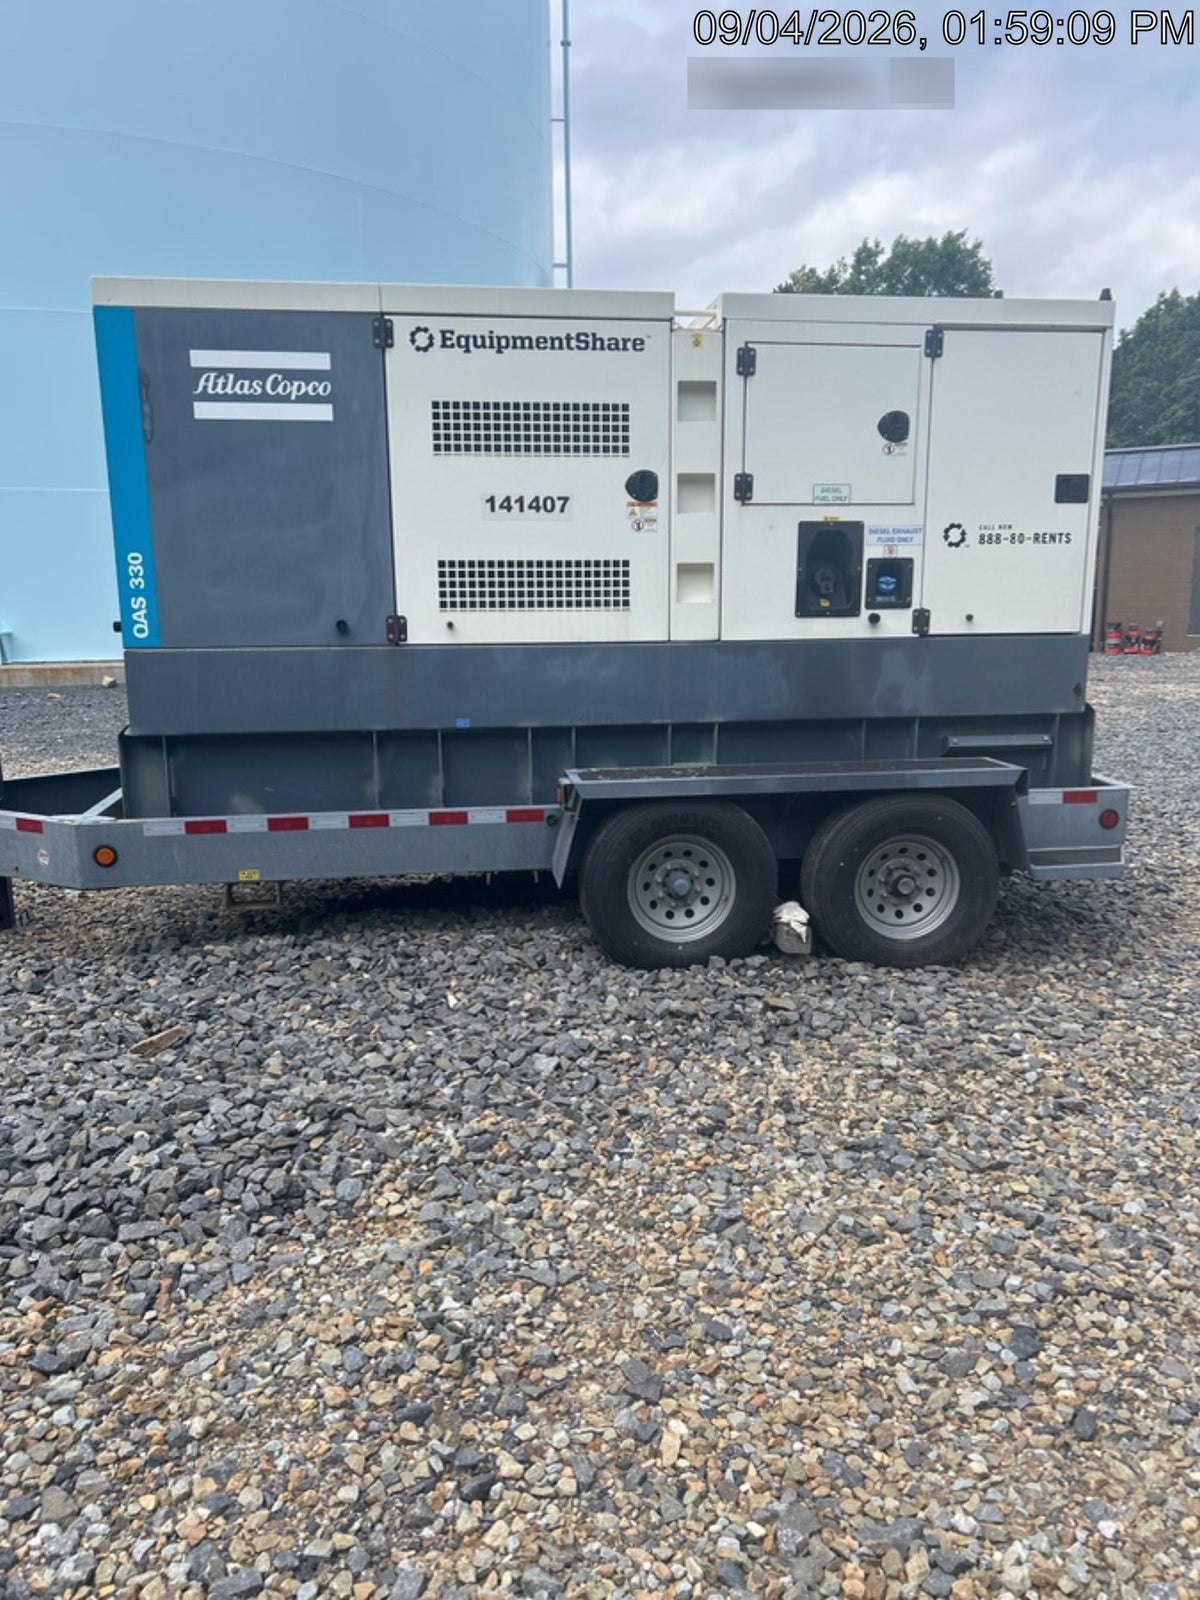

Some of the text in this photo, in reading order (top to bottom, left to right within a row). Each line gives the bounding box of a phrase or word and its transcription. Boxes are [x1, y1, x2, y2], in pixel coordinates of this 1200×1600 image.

[439, 329, 646, 354] EquipmentShare
[193, 372, 332, 401] Atlas Copco
[484, 495, 571, 514] 141407
[978, 532, 1072, 545] 888-80-RENTS
[127, 552, 145, 590] 330
